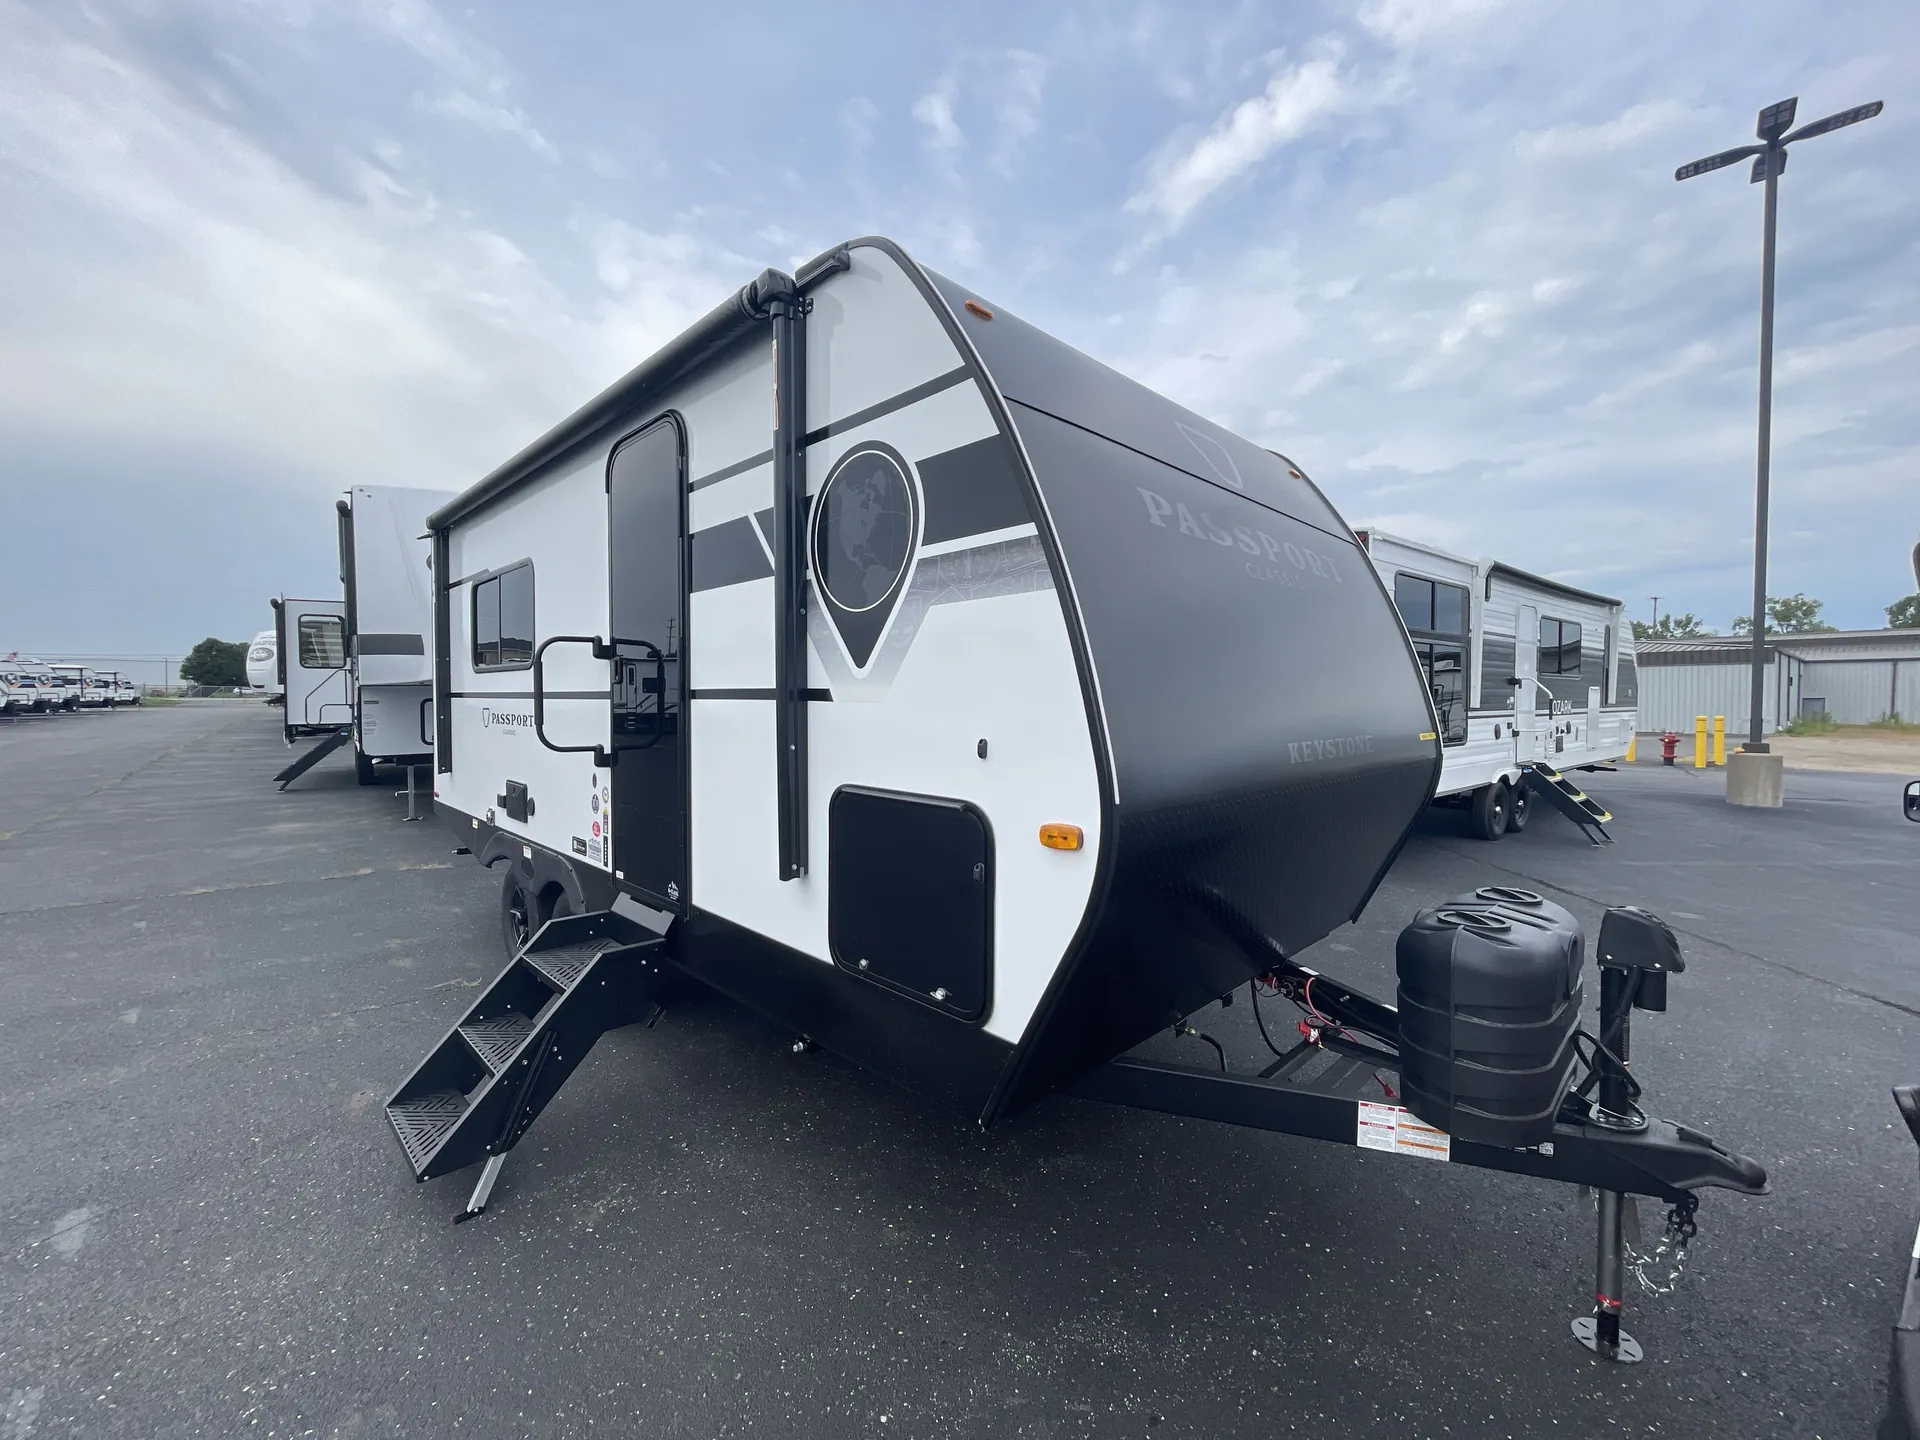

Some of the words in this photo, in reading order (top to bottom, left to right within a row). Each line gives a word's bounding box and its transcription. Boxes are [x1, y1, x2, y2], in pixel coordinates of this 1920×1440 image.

[1137, 486, 1343, 583] PASSPORT
[1552, 700, 1573, 714] OZARK
[491, 712, 534, 727] PASSPORT
[1287, 735, 1374, 764] KEYSTONE
